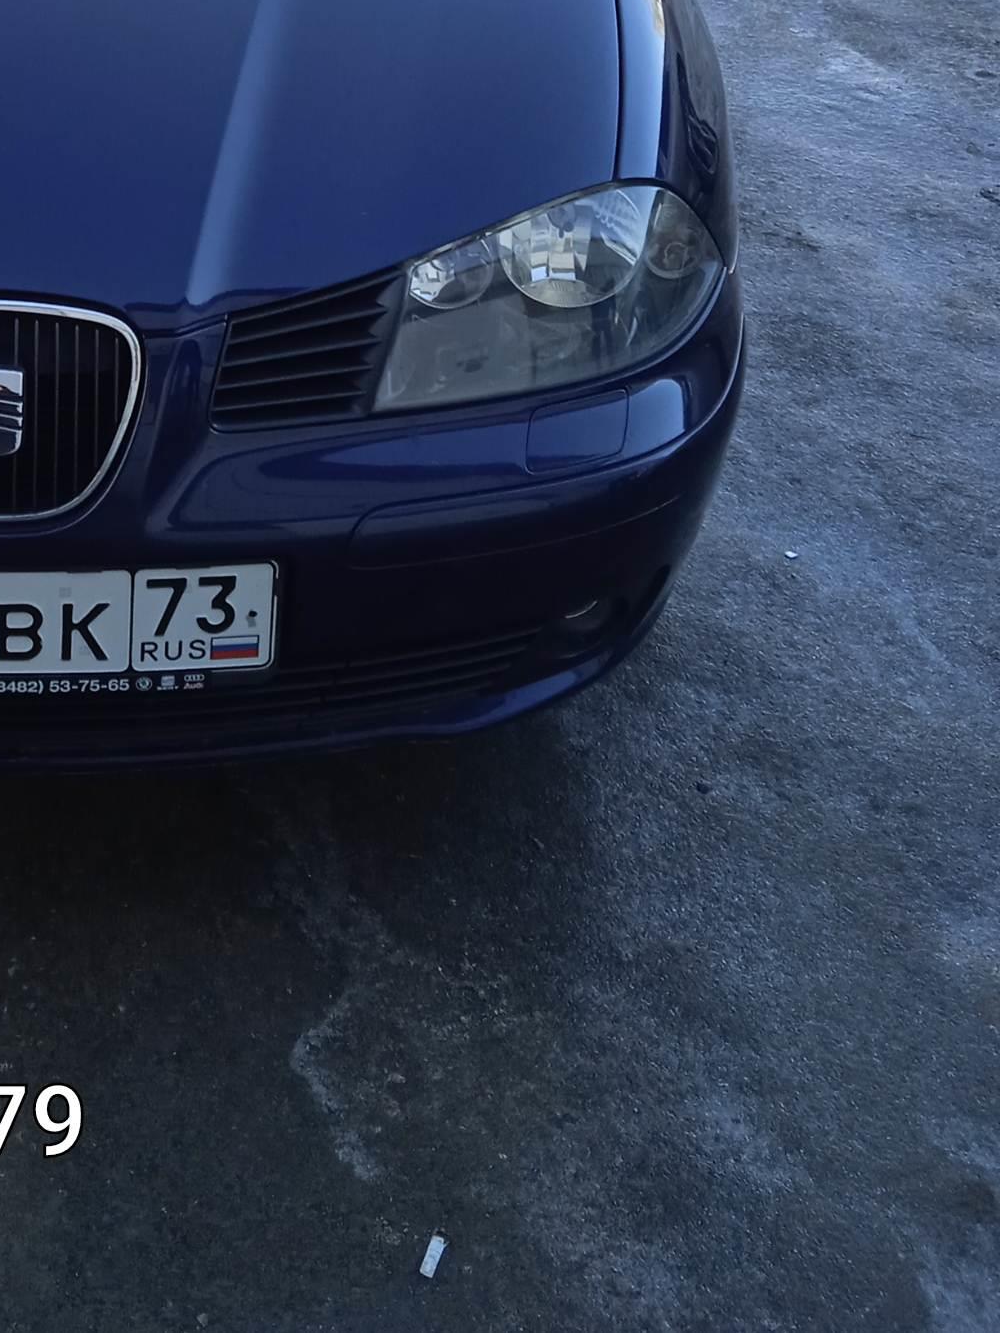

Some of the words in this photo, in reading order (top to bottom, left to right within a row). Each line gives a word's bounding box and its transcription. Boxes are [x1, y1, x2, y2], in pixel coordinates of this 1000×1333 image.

[146, 575, 237, 637] 73
[140, 638, 206, 663] RUS
[49, 678, 130, 693] 53-75-65
